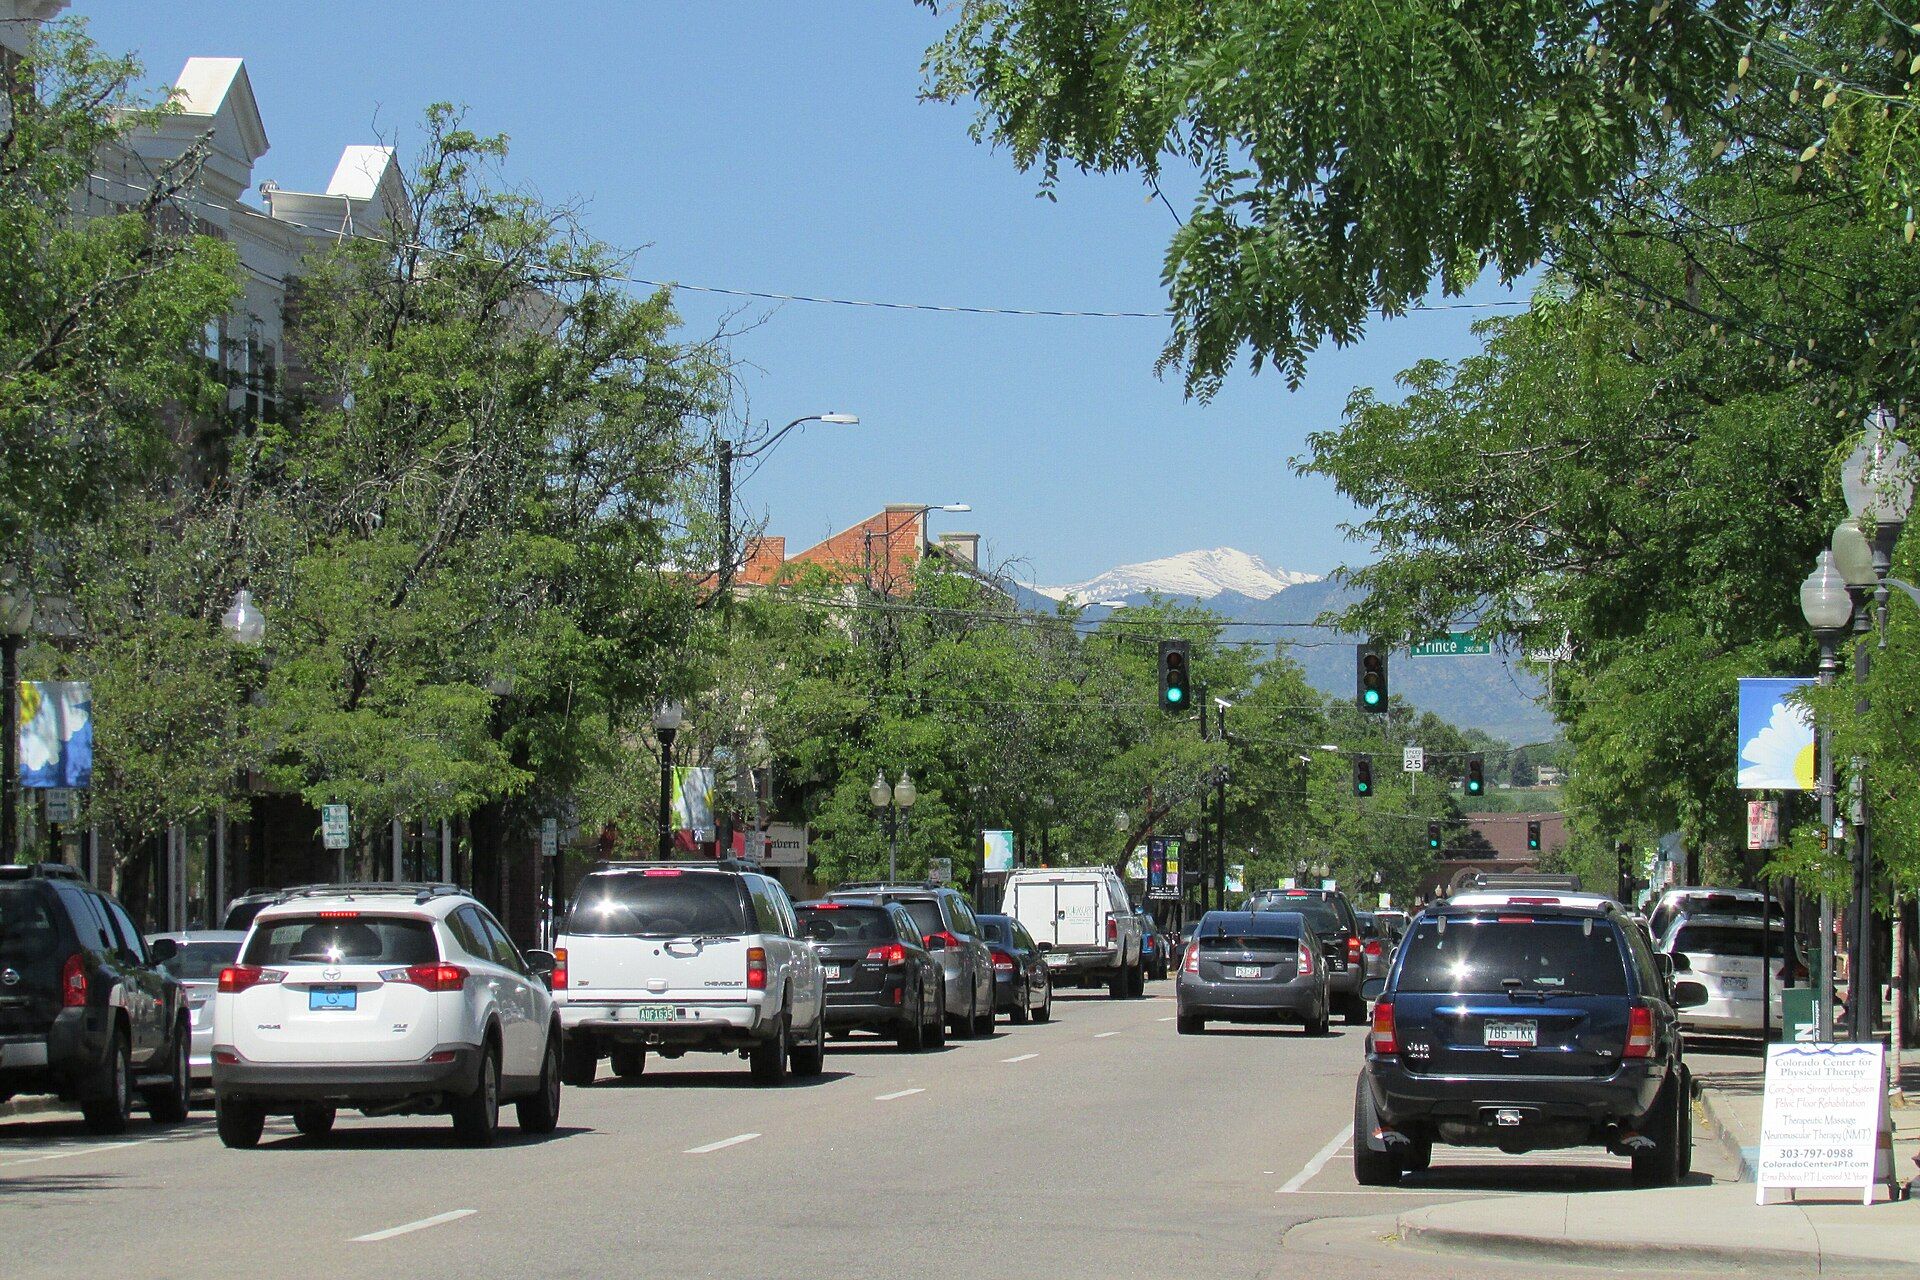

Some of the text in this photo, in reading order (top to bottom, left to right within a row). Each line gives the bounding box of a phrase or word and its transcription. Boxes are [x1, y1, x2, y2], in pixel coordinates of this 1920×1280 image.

[1405, 760, 1421, 768] 25
[1775, 1057, 1873, 1067] Colorado Center for
[1780, 1067, 1866, 1078] Physical Therapy
[1806, 1084, 1851, 1095] Strengthening
[1851, 1083, 1875, 1094] System
[1775, 1097, 1866, 1108] Pelvic Floor Rehabilitation
[1783, 1114, 1857, 1128] Therapeutic Massage
[1763, 1127, 1872, 1142] Neuromuscular Therapy (NMT)
[1779, 1148, 1854, 1159] 303-797-0988
[1762, 1160, 1869, 1168] ColoradoCenter4PT.com
